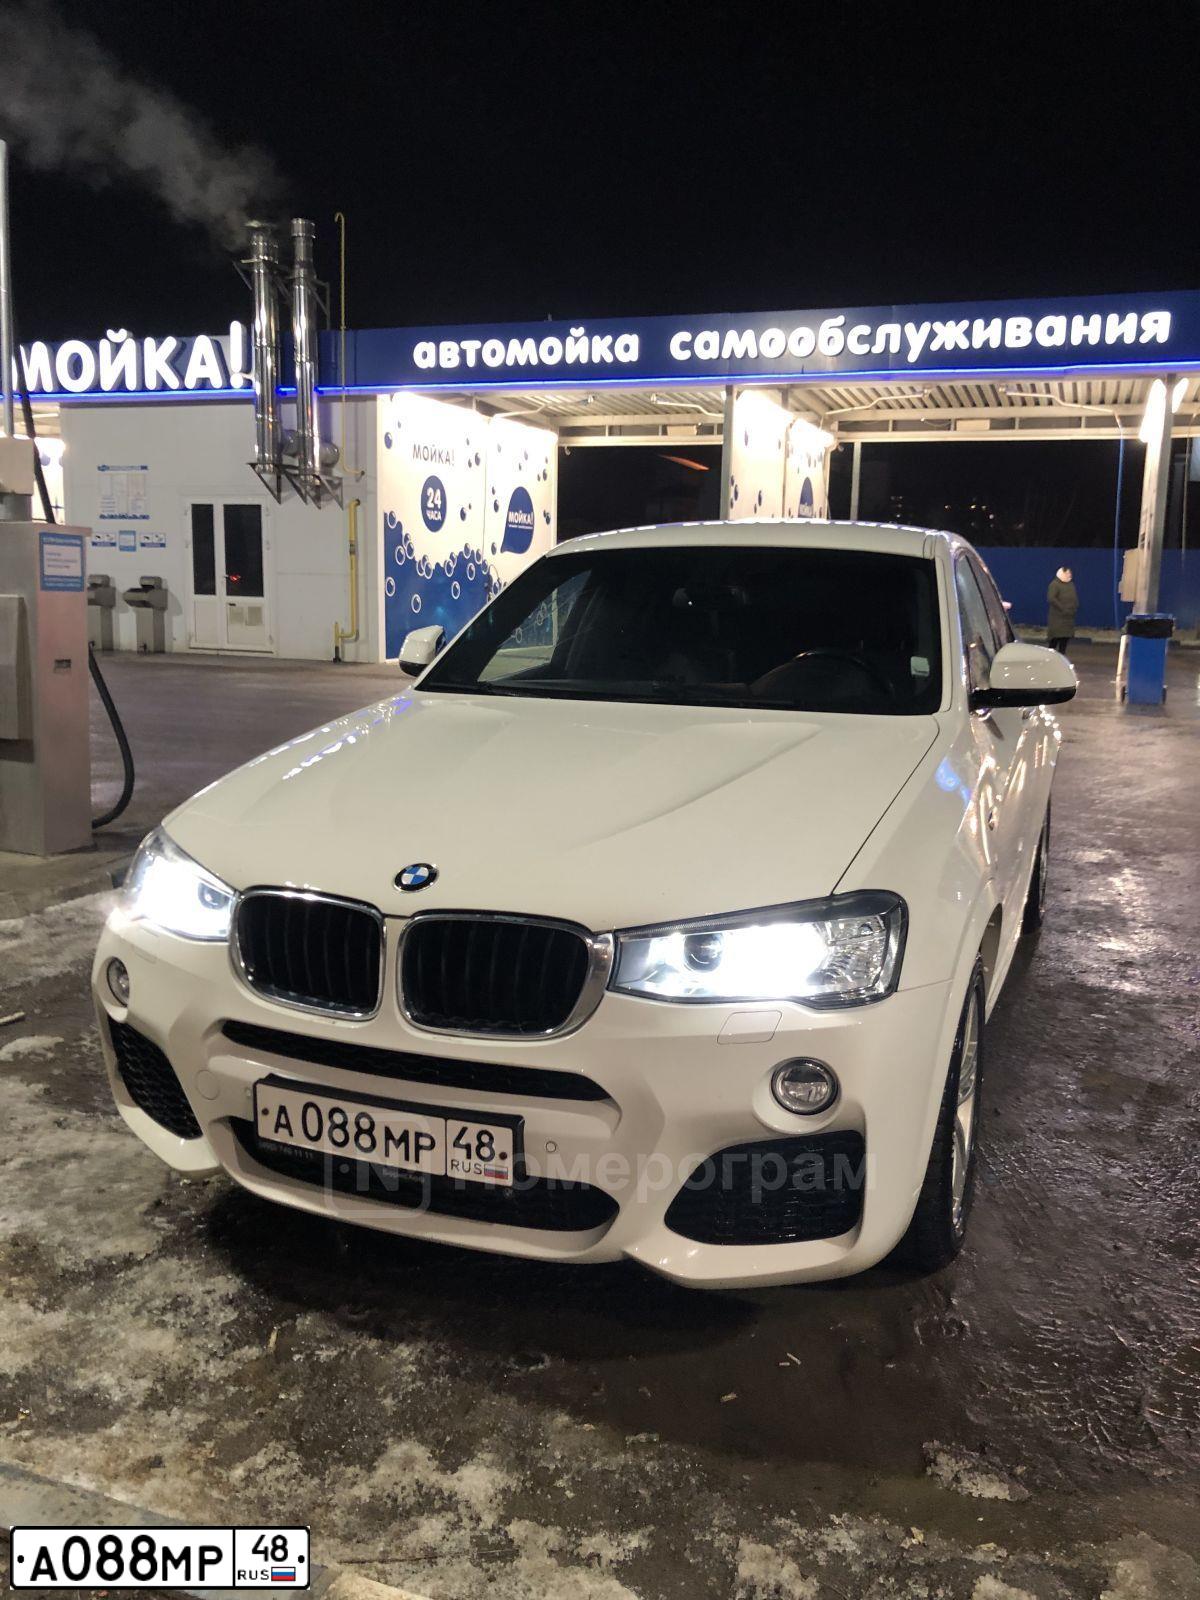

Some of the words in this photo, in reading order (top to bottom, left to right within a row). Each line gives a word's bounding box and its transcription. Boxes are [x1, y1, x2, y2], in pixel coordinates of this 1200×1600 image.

[413, 326, 639, 369] автомойка
[669, 310, 1172, 363] самообслуживания
[412, 444, 455, 467] МОЙКА!
[426, 487, 442, 509] 24
[273, 1101, 436, 1164] А088МР
[452, 1126, 496, 1162] 48
[450, 1159, 483, 1176] RUS
